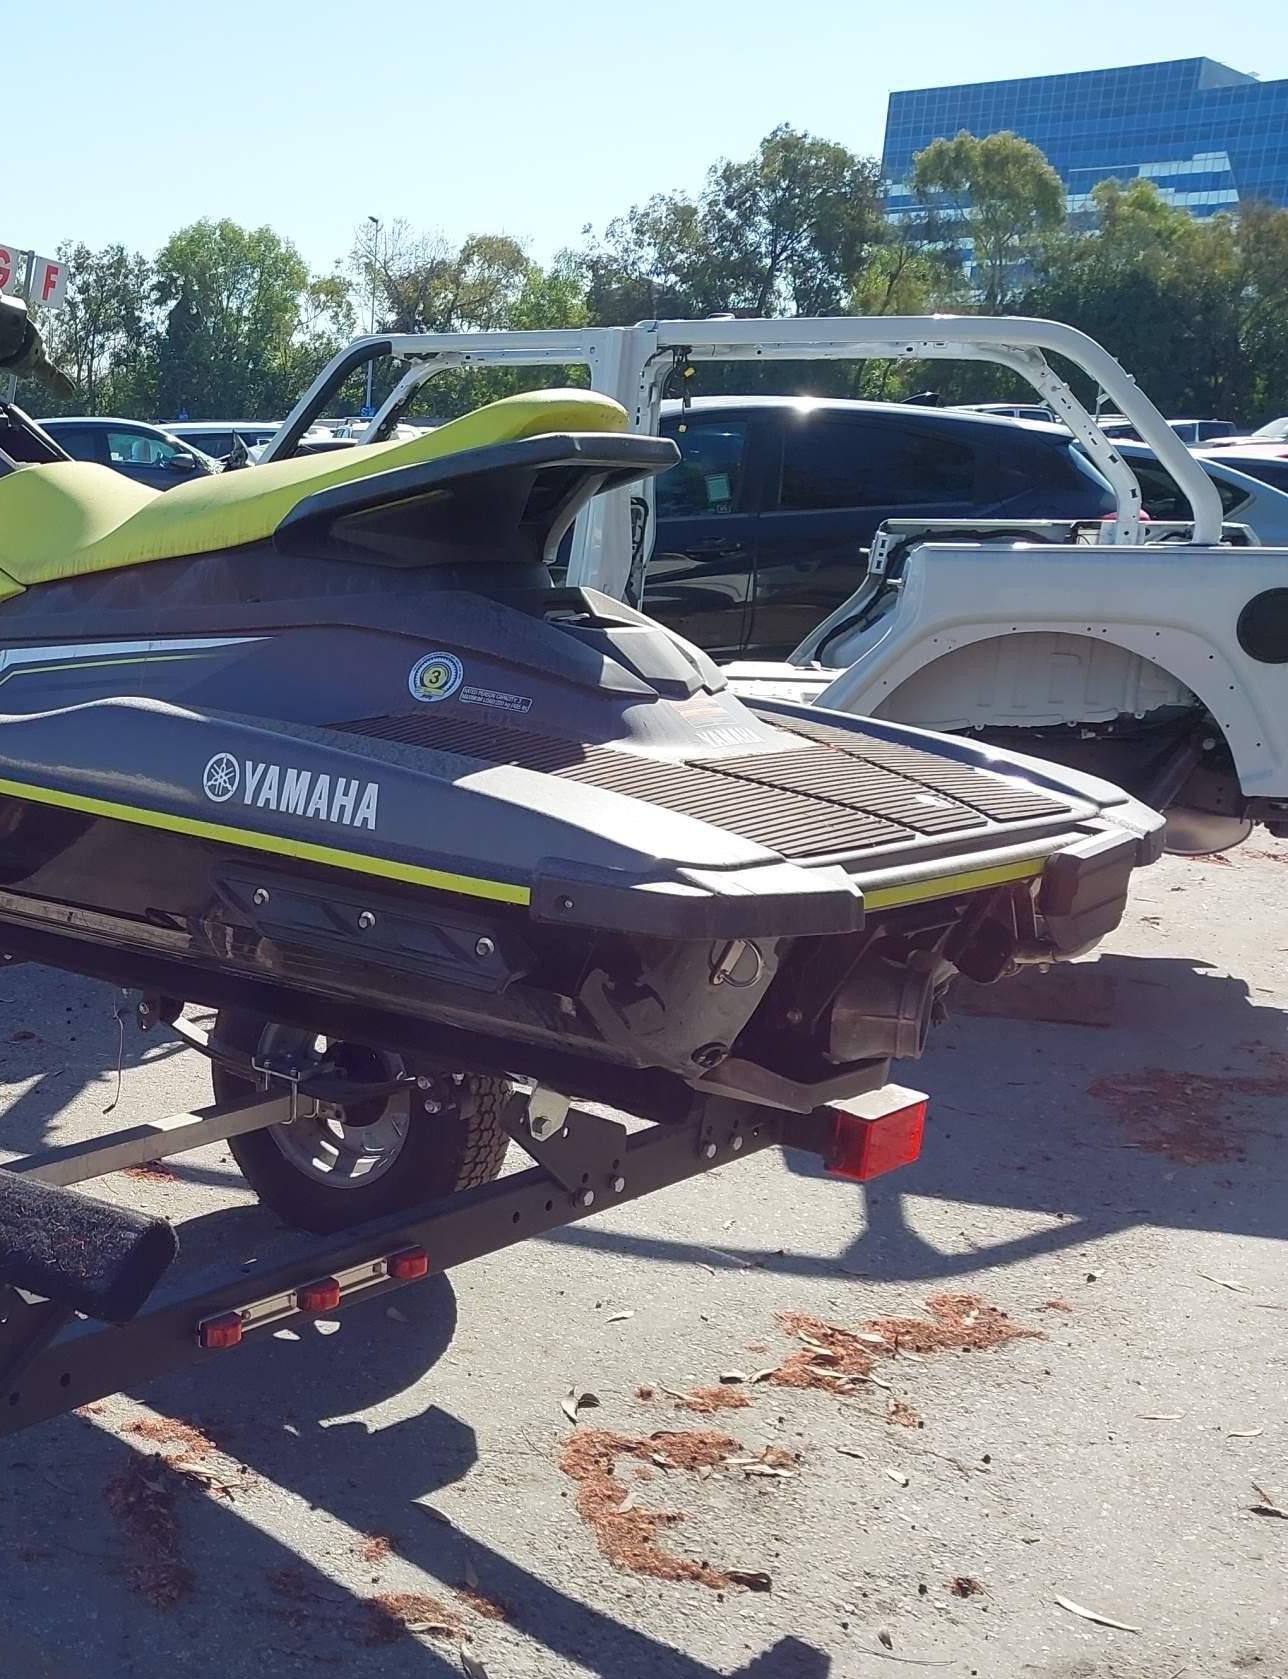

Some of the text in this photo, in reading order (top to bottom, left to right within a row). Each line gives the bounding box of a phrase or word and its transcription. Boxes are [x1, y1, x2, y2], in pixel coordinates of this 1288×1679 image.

[41, 264, 59, 301] F
[428, 669, 441, 684] 3
[244, 760, 380, 830] YAMAHA
